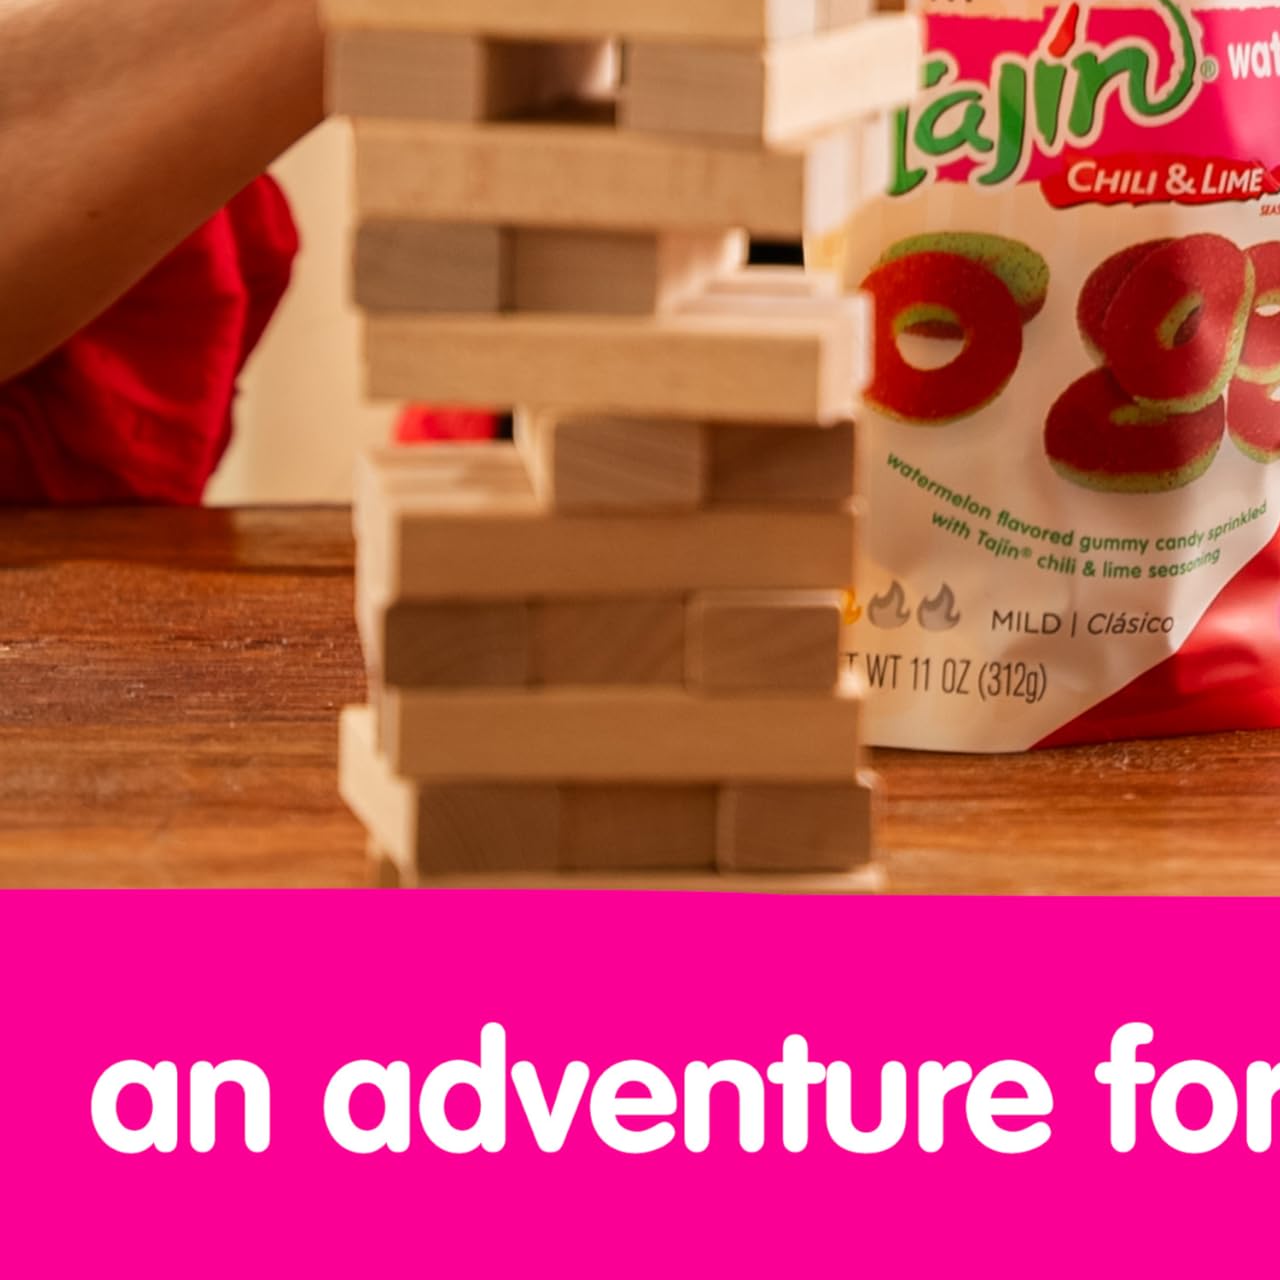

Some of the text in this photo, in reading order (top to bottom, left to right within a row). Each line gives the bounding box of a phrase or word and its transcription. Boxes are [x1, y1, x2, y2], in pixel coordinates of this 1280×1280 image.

[1067, 160, 1265, 196] CHILI & LIME
[886, 452, 1268, 556] watermelon flavored gummy candy sprinkled
[931, 511, 972, 540] with
[1036, 553, 1077, 576] chili
[1082, 560, 1097, 578] &
[1102, 561, 1142, 580] lime
[1147, 548, 1221, 580] seasoning
[990, 609, 1175, 636] MILD Clásico
[866, 653, 902, 691] WT
[909, 656, 931, 692] 11
[941, 657, 972, 696] OZ
[977, 660, 1048, 705] (312g)
